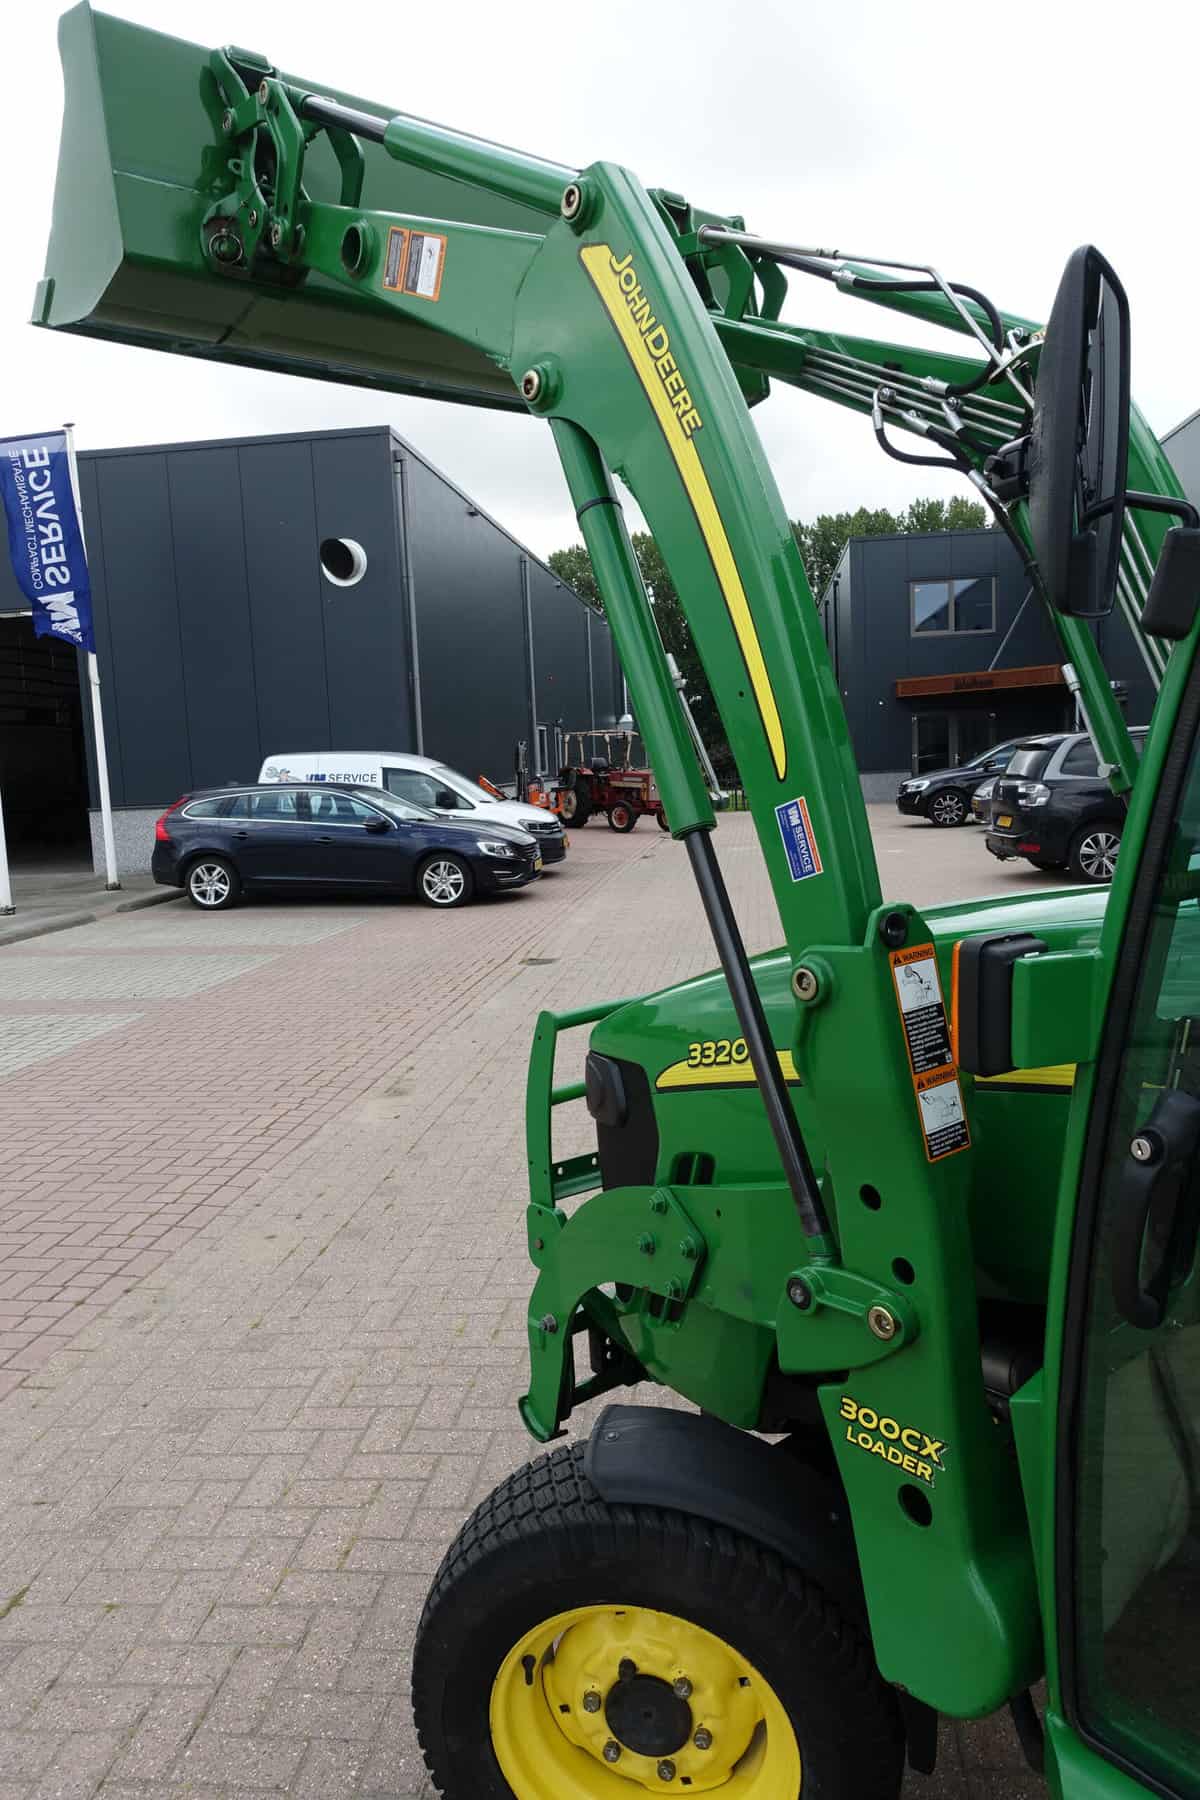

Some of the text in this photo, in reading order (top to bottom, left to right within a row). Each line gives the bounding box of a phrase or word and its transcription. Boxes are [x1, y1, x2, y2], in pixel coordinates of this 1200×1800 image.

[610, 254, 703, 438] JOHN DEERE
[328, 773, 377, 783] SERVICE
[795, 826, 813, 872] SERVICE
[902, 947, 934, 963] WARNING
[688, 1038, 749, 1067] 3320
[926, 1068, 957, 1086] WARNING
[840, 1396, 943, 1464] 300CX
[846, 1424, 933, 1481] LOADER
